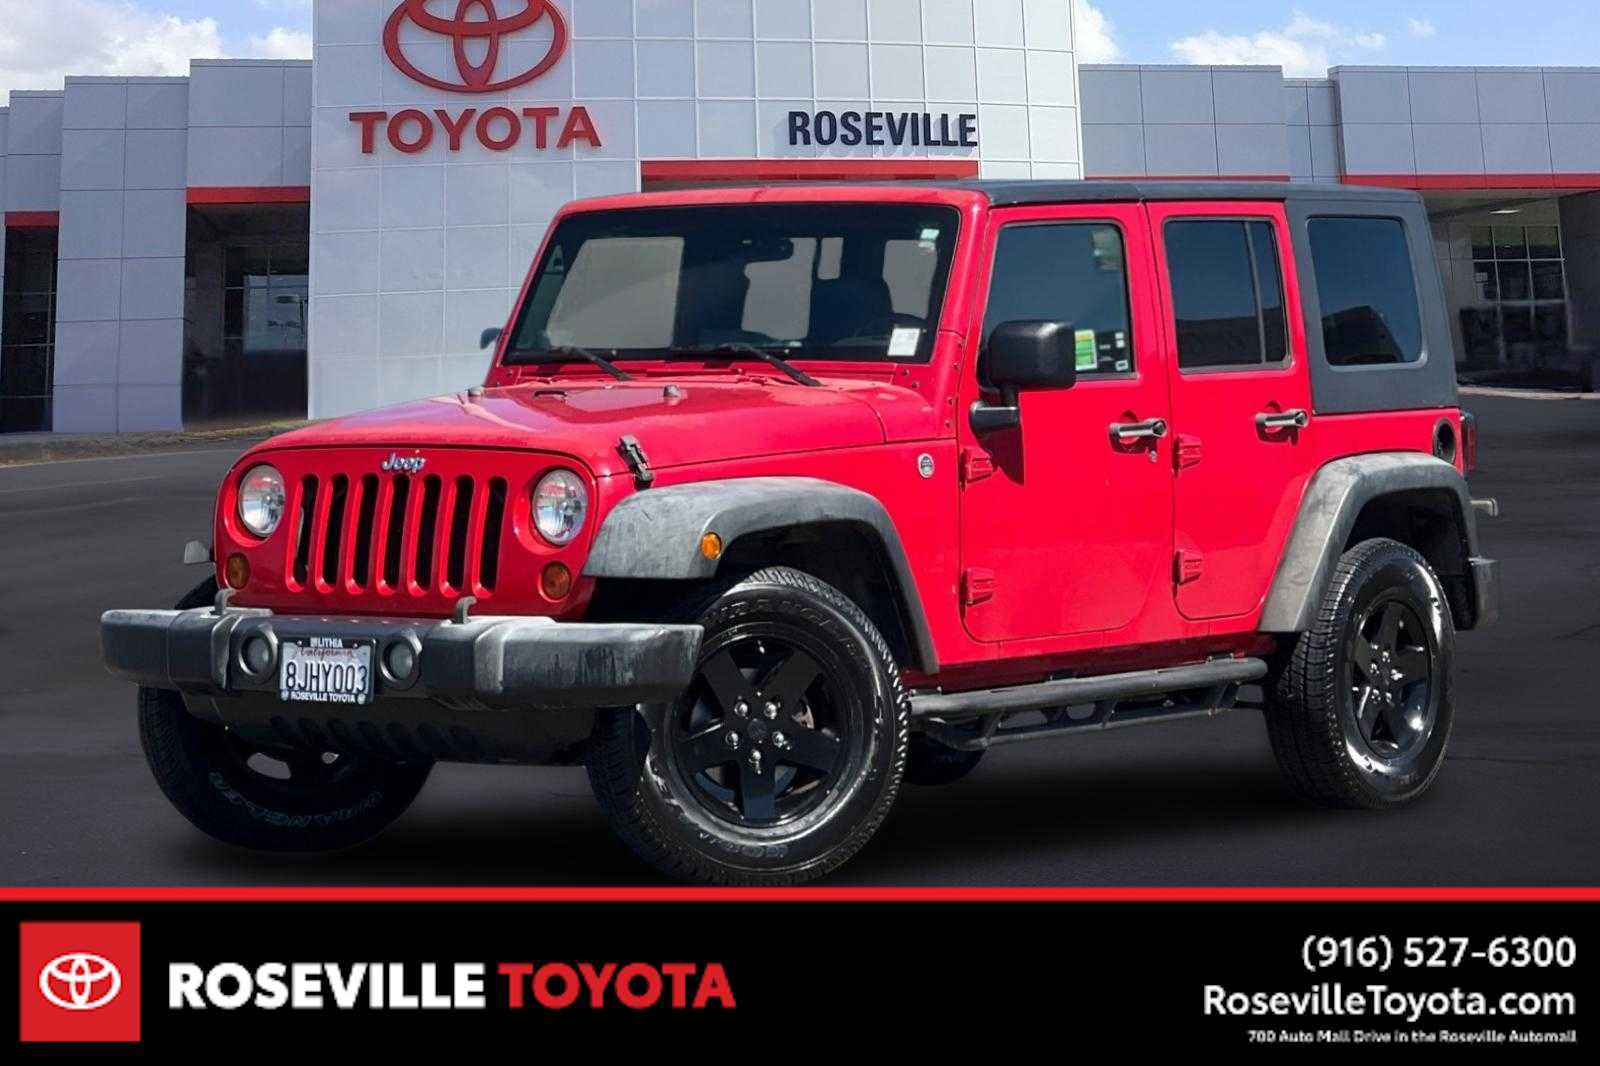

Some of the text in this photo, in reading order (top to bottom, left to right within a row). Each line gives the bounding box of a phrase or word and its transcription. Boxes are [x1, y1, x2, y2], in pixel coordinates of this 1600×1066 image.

[349, 106, 602, 153] TOYOTA
[789, 111, 978, 146] ROSEVILLE
[381, 452, 426, 473] Jeep
[286, 661, 368, 693] 8JHY003
[290, 691, 356, 703] ROSEVILLE TOYOTA
